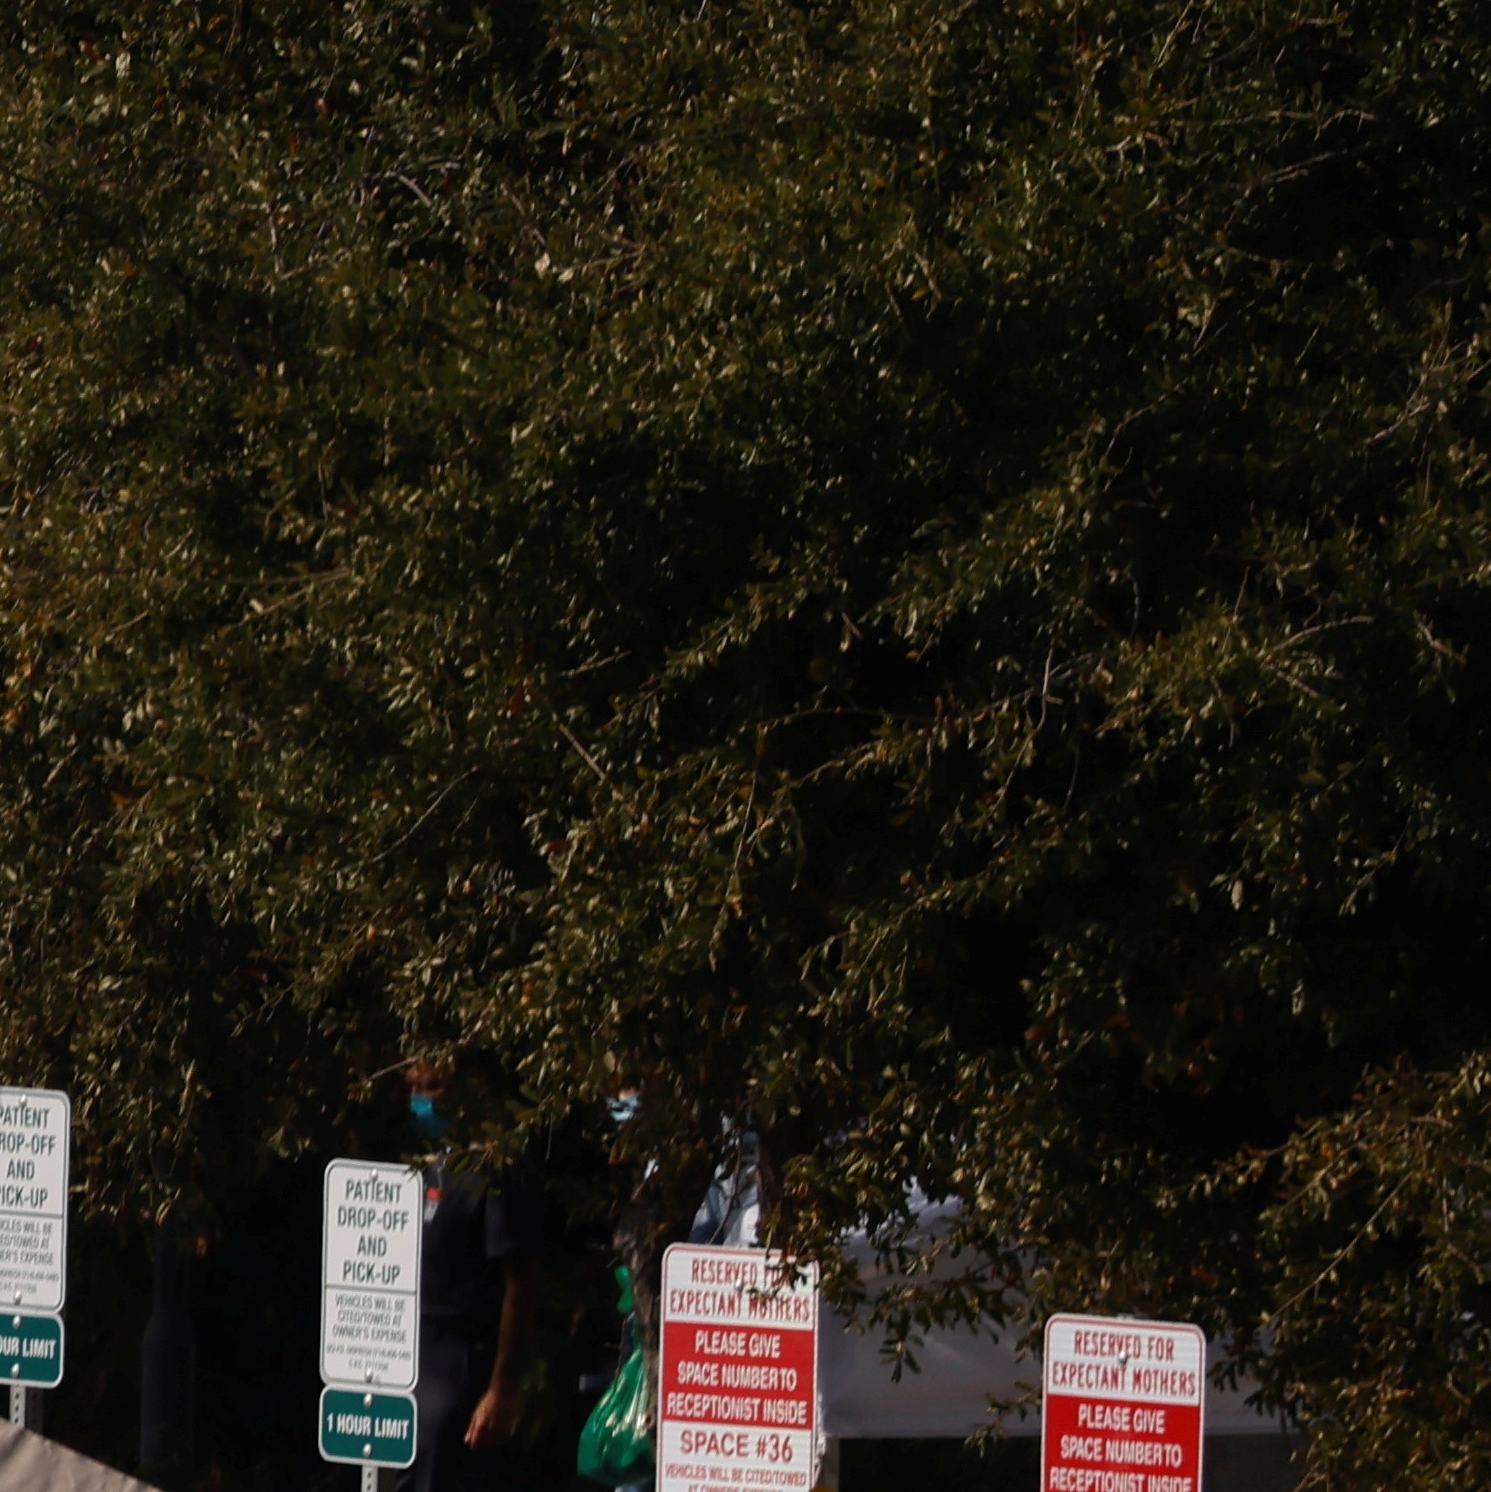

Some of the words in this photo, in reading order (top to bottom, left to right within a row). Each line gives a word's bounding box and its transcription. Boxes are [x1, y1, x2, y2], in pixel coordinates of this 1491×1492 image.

[7, 1159, 35, 1180] AND
[346, 1179, 403, 1204] PATIENT
[337, 1206, 410, 1232] DROP-OFF
[357, 1234, 387, 1257] AND
[342, 1261, 401, 1285] PICK-UP
[691, 1258, 757, 1286] RESERVED
[670, 1288, 743, 1318] EXPECTANT
[748, 1292, 810, 1322] MOTHERS
[22, 1338, 57, 1359] LIMIT
[371, 1328, 407, 1344] EXPENSE
[695, 1329, 747, 1357] PLEASE
[748, 1333, 781, 1358] GIVE
[1074, 1330, 1141, 1359] RESERVED
[1147, 1336, 1175, 1362] FOR
[677, 1360, 719, 1387] SPACE
[1052, 1361, 1127, 1392] EXPECTANT
[1132, 1367, 1196, 1397] MOTHERS
[667, 1392, 761, 1421] RECEPTIONIST
[763, 1399, 807, 1424] INSIDE
[1078, 1403, 1131, 1432] PLEASE
[1133, 1408, 1166, 1434] GIVE
[327, 1412, 333, 1433] 1
[336, 1413, 371, 1437] HOUR
[374, 1417, 410, 1441] LIMIT
[680, 1429, 749, 1458] SPACE
[756, 1433, 794, 1464] #36
[1060, 1434, 1102, 1462] SPACE
[665, 1463, 707, 1481] VEHICLES
[709, 1466, 730, 1482] WILL
[732, 1468, 743, 1483] BE
